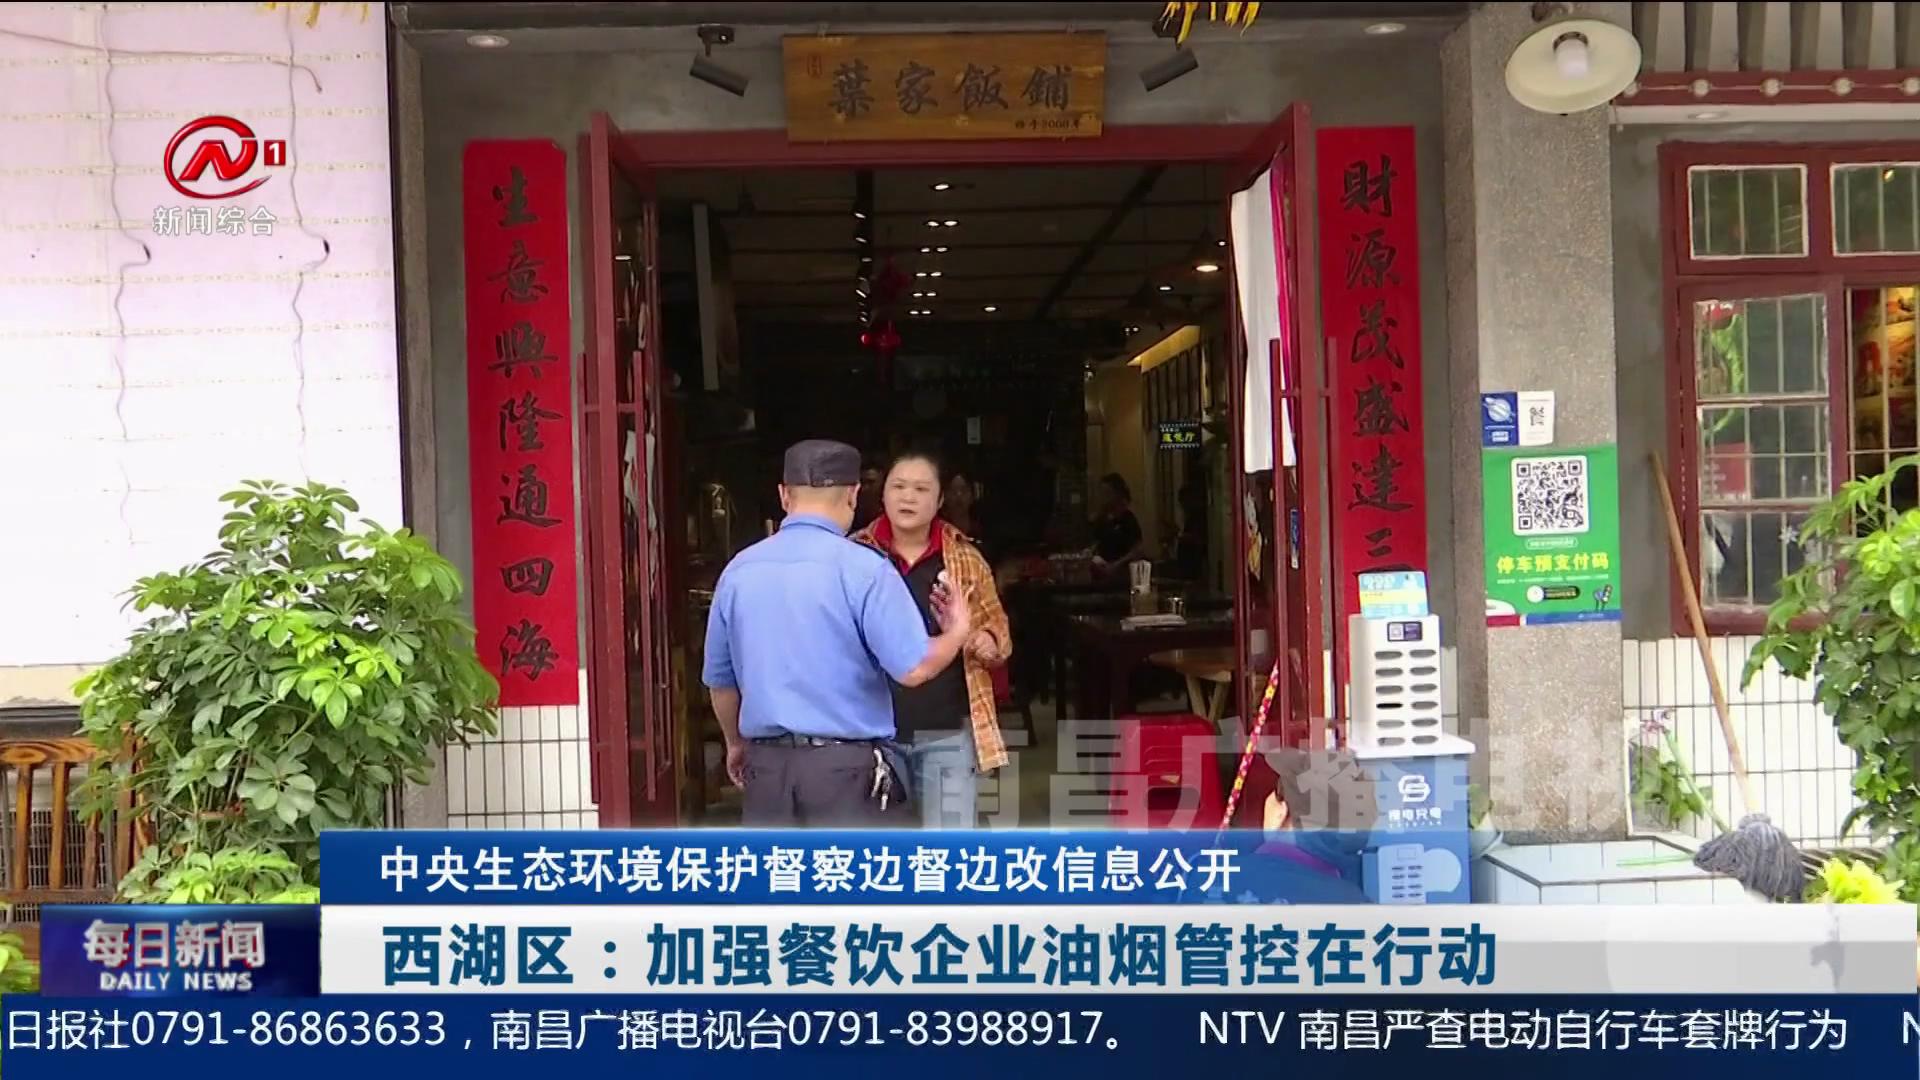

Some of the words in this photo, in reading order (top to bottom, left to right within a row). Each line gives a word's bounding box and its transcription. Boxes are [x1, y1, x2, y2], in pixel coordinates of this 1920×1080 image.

[827, 58, 1073, 118] 葉家飯鋪
[487, 164, 563, 683] 生意興隆通四海
[1496, 552, 1609, 574] 停车预支付码
